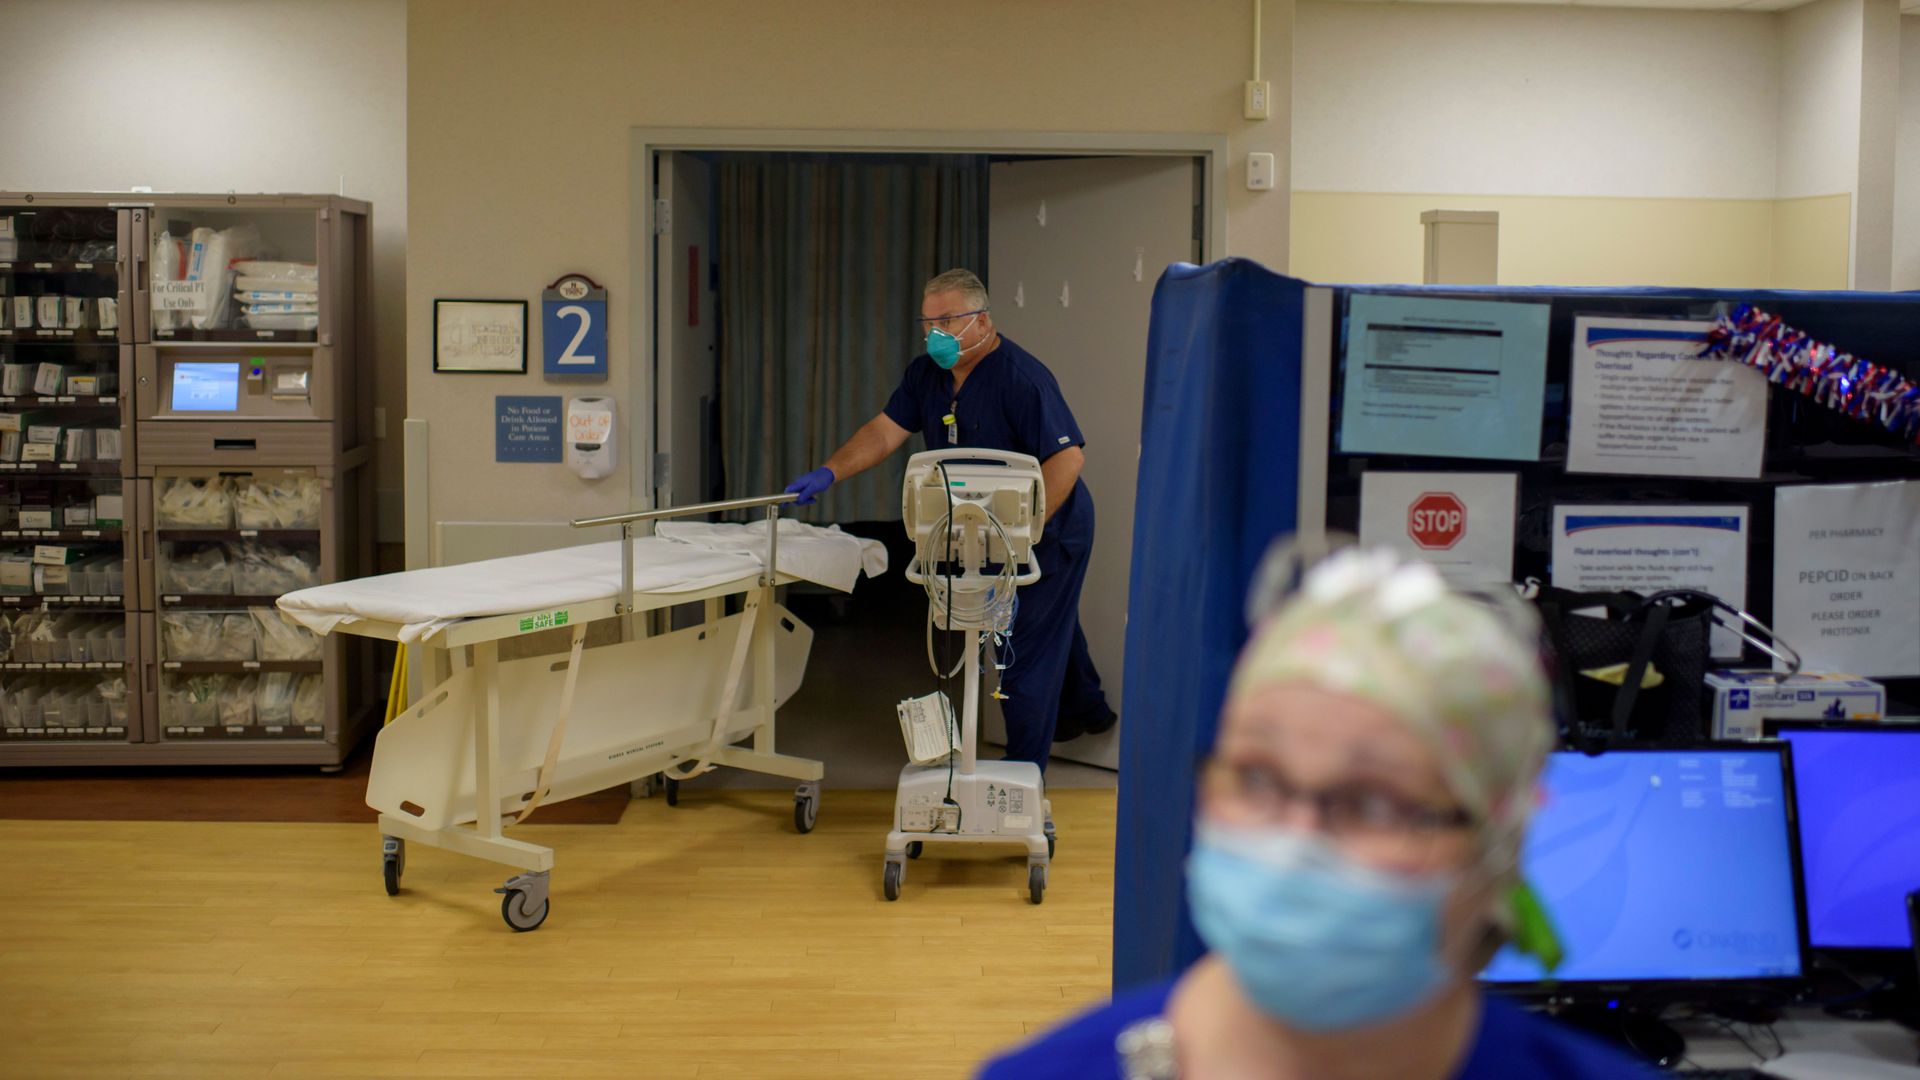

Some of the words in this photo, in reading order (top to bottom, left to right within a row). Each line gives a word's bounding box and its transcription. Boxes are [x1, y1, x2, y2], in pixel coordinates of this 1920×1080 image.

[135, 213, 142, 222] 2
[152, 282, 164, 292] For
[166, 282, 193, 293] Critical
[163, 298, 176, 308] Use
[178, 297, 195, 308] Only
[556, 305, 595, 364] 2
[1596, 349, 1633, 360] Thoughts
[1636, 351, 1676, 360] Regarding
[1594, 362, 1632, 370] Overload
[1414, 509, 1461, 532] STOP
[1808, 530, 1827, 539] PER
[1829, 528, 1884, 538] PHARMACY
[1574, 547, 1594, 556] Fluid
[1596, 548, 1632, 556] overload
[1634, 548, 1670, 557] thoughts
[1798, 569, 1849, 584] PEPCID
[1851, 572, 1866, 581] ON
[1869, 570, 1894, 580] BACK
[1830, 592, 1863, 602] ORDER
[1810, 610, 1844, 621] PLEASE
[1848, 609, 1880, 619] ORDER
[535, 618, 554, 628] SAFE
[1820, 626, 1870, 637] PROTONIX
